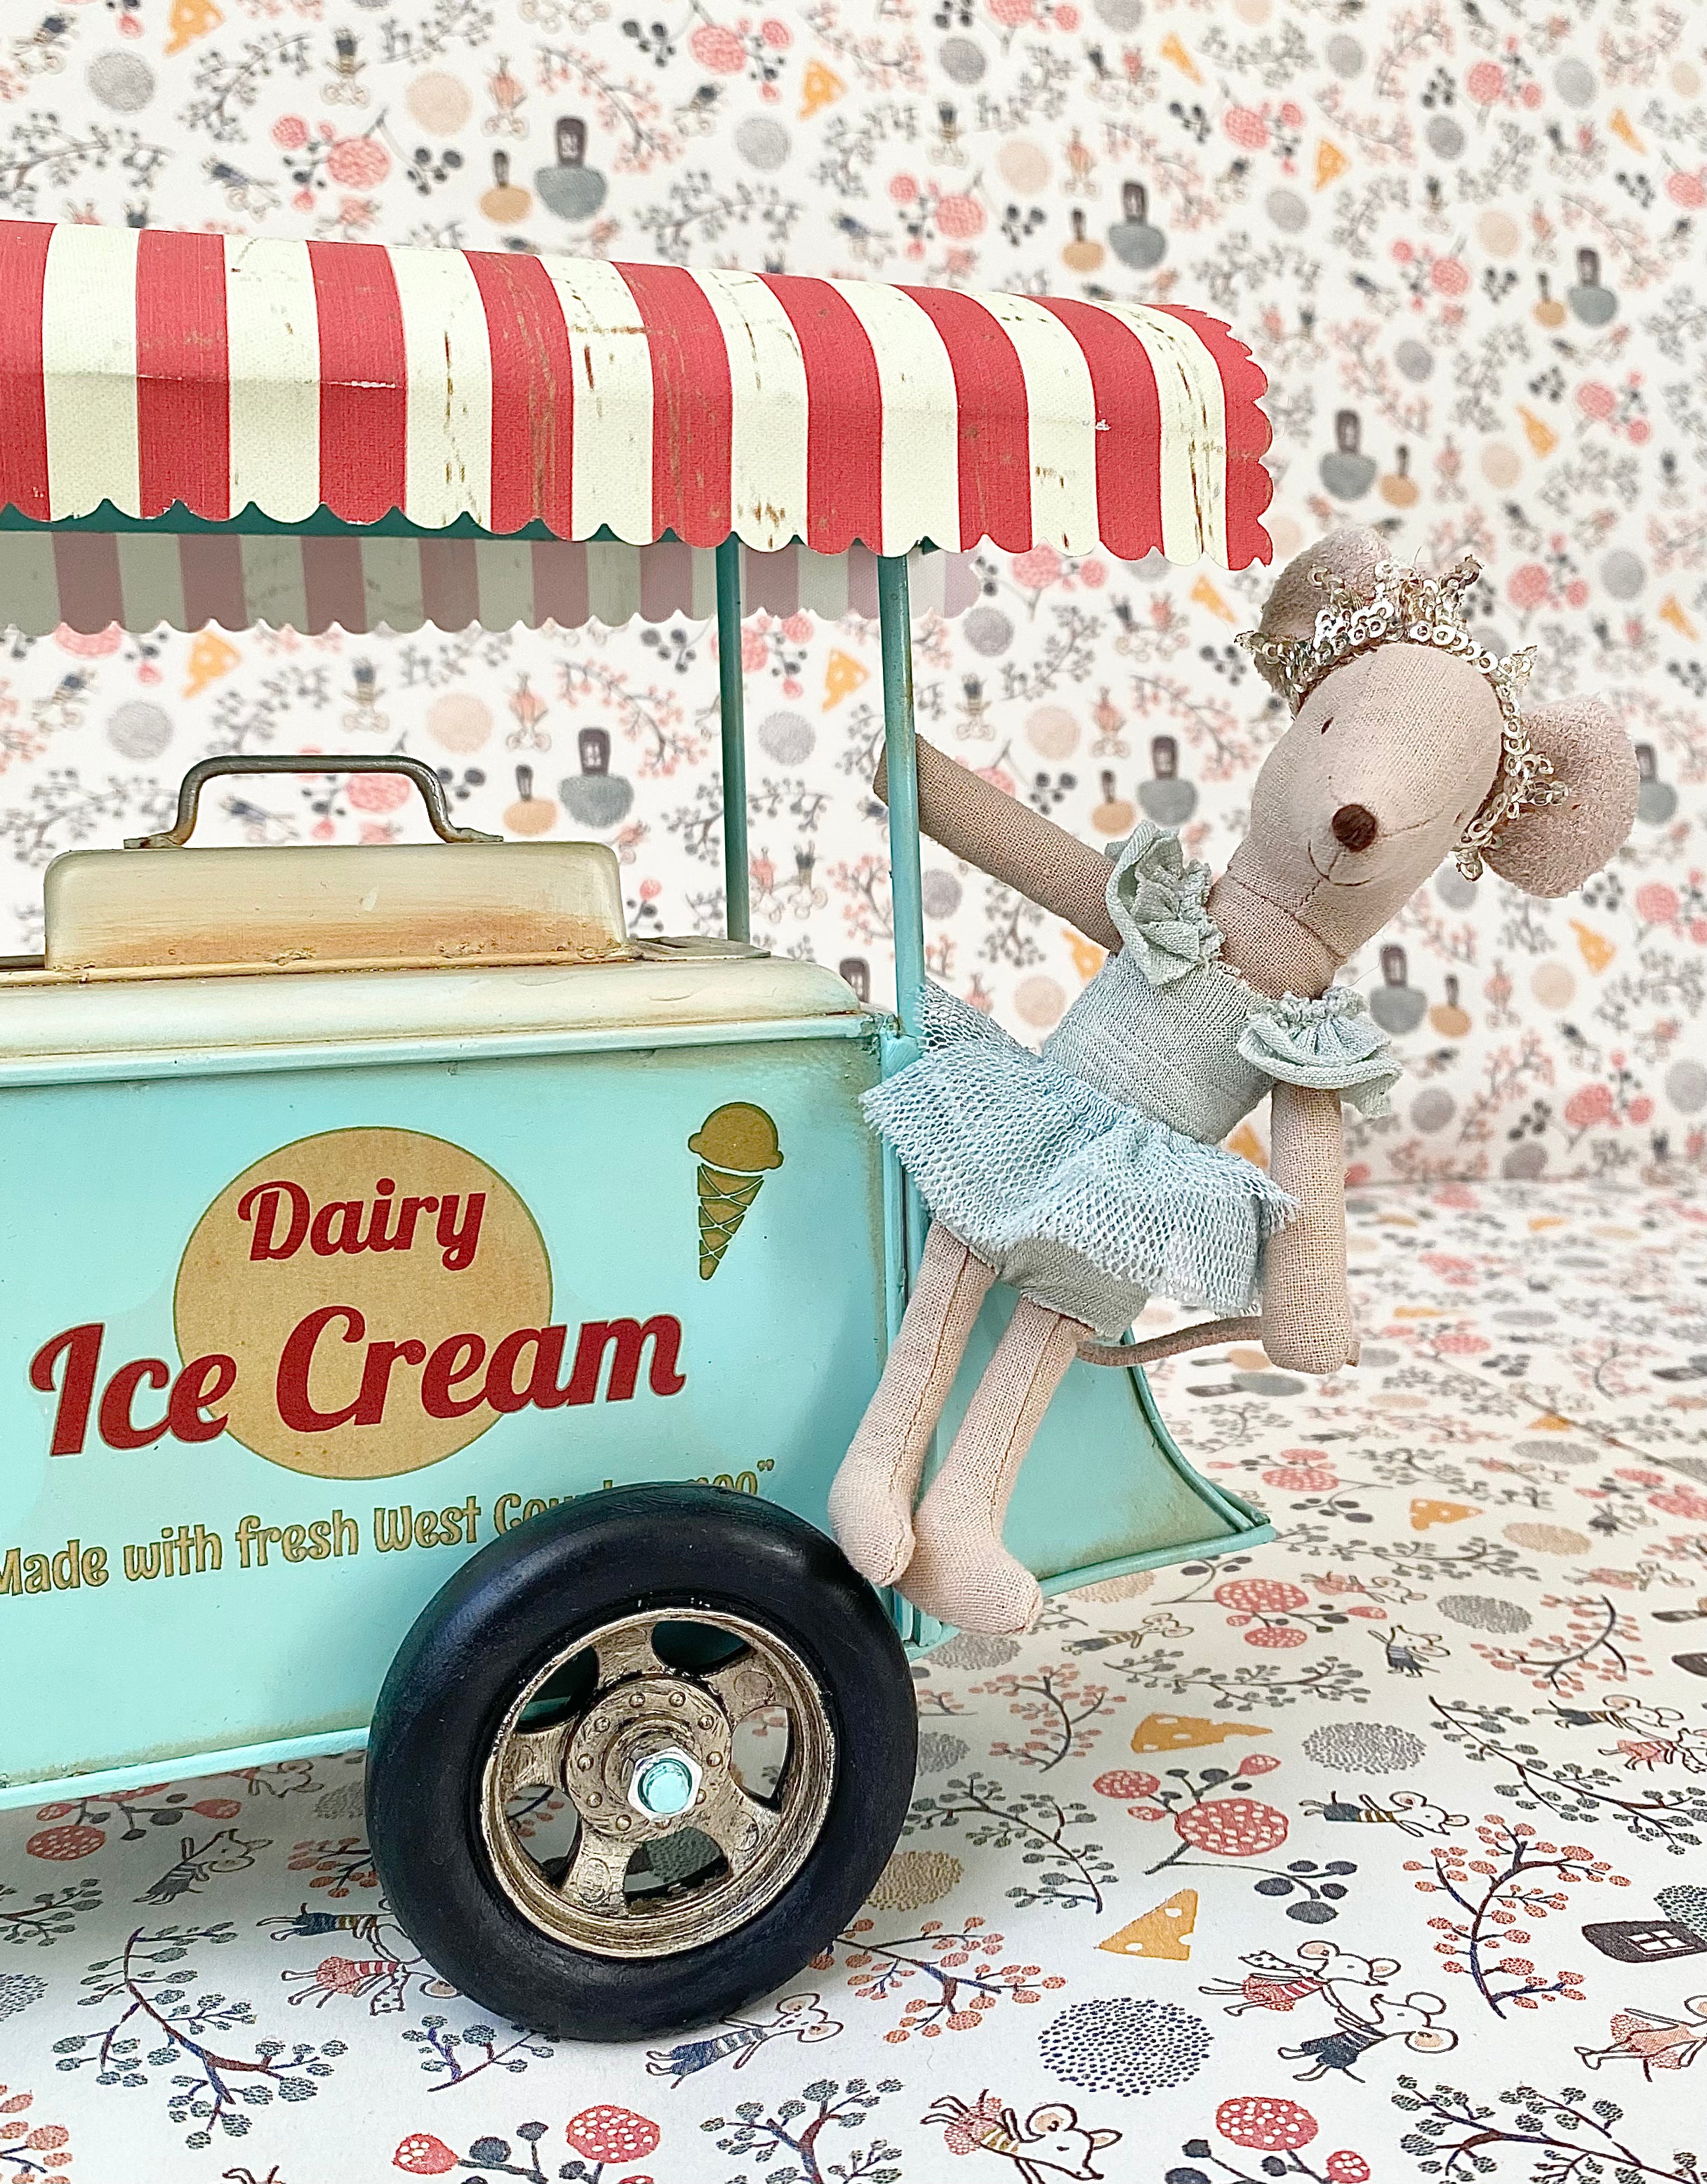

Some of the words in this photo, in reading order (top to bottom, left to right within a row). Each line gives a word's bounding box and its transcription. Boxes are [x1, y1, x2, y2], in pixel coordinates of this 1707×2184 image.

[237, 1177, 486, 1271] Dairy
[29, 1322, 238, 1456] Ice
[276, 1304, 686, 1433] Cream
[124, 1524, 222, 1582] with
[235, 1509, 359, 1568] fresh
[373, 1495, 481, 1553] West
